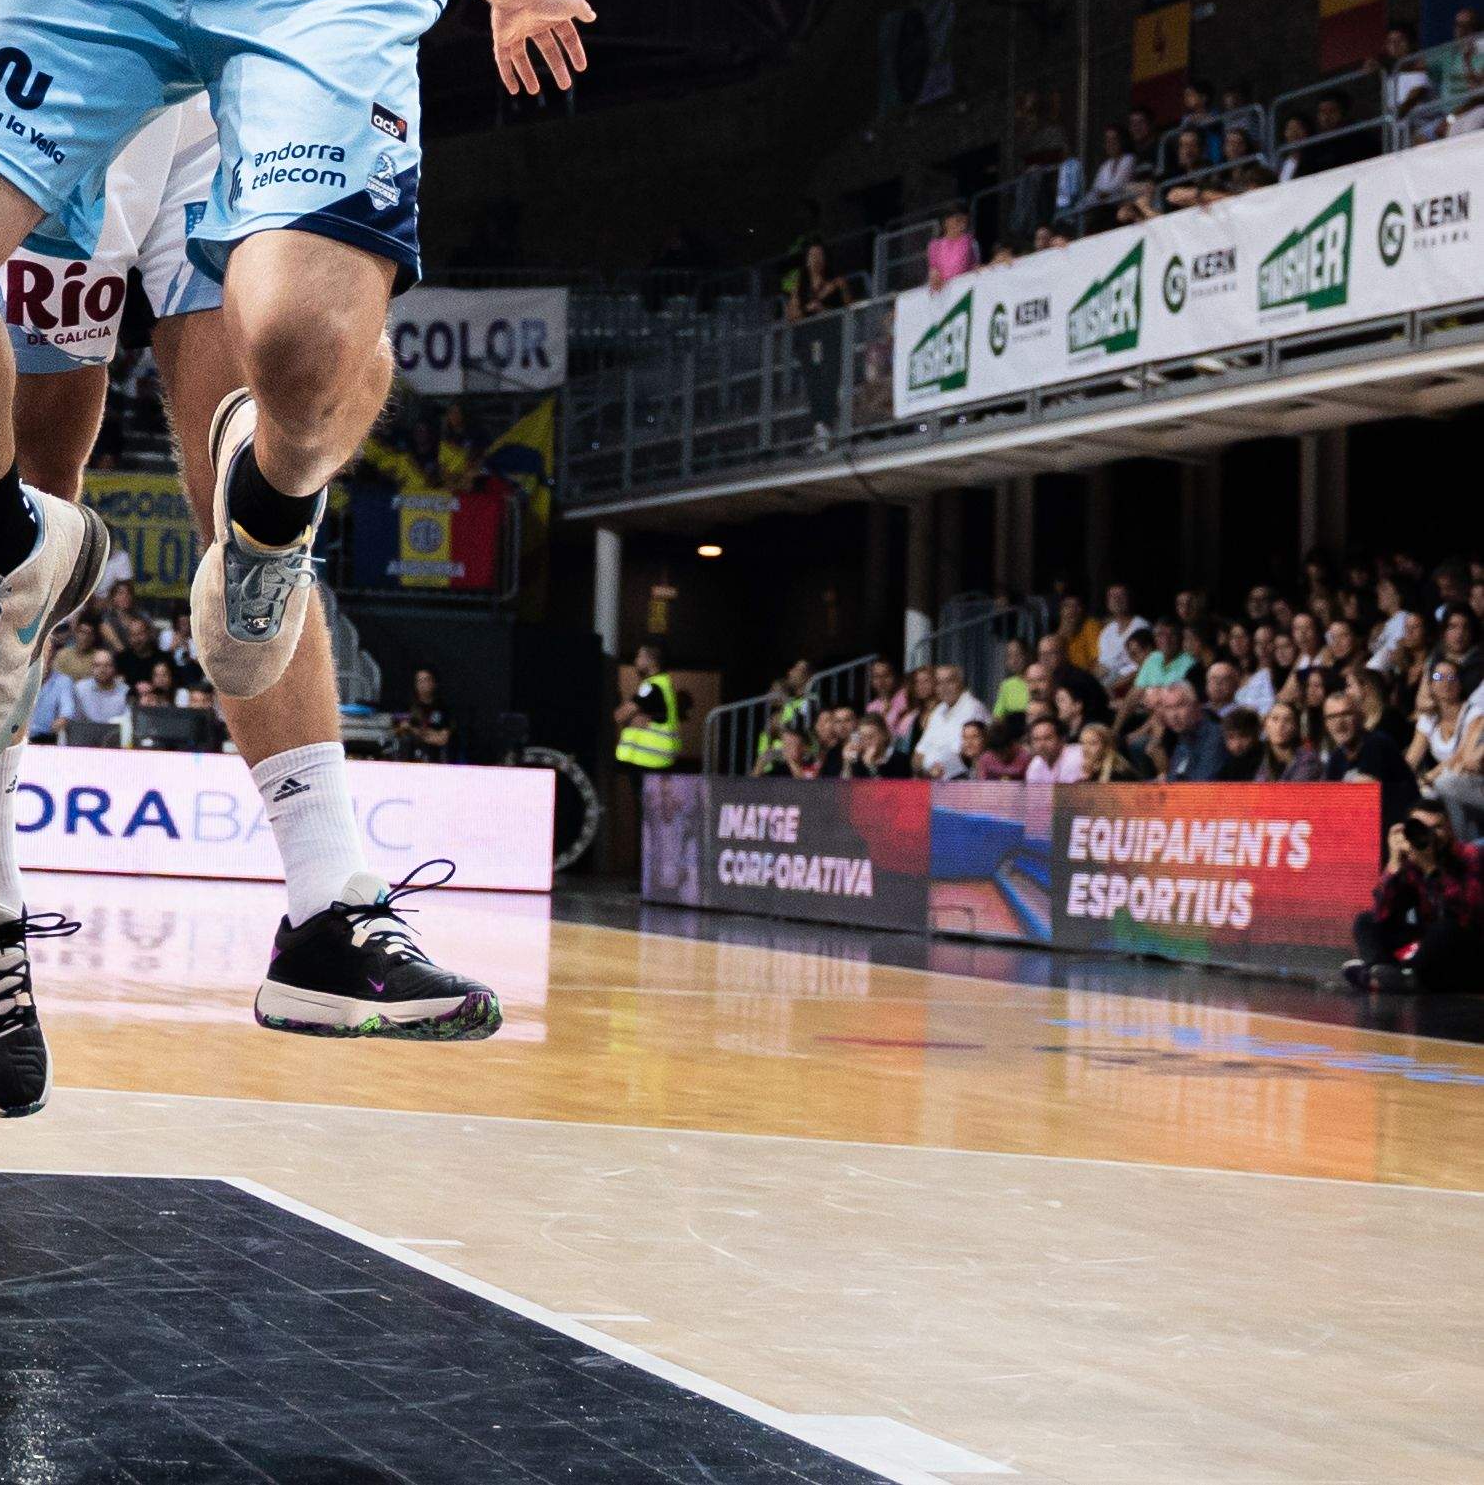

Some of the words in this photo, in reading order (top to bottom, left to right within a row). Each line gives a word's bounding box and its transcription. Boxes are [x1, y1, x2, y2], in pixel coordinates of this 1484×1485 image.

[4, 111, 28, 137] la
[27, 120, 66, 166] Vella
[373, 114, 400, 137] acb
[253, 140, 346, 166] andorra
[250, 165, 347, 190] telecom
[1412, 189, 1471, 230] KERN
[1191, 245, 1238, 283] KERN
[6, 258, 127, 331] Río
[26, 330, 51, 348] DE
[53, 324, 113, 347] GALICIA
[718, 803, 802, 844] IMATGE
[1067, 814, 1312, 872] EQUIPAMENTS
[717, 848, 874, 897] CORPORATIVA
[1067, 871, 1254, 932] ESPORTIUS
